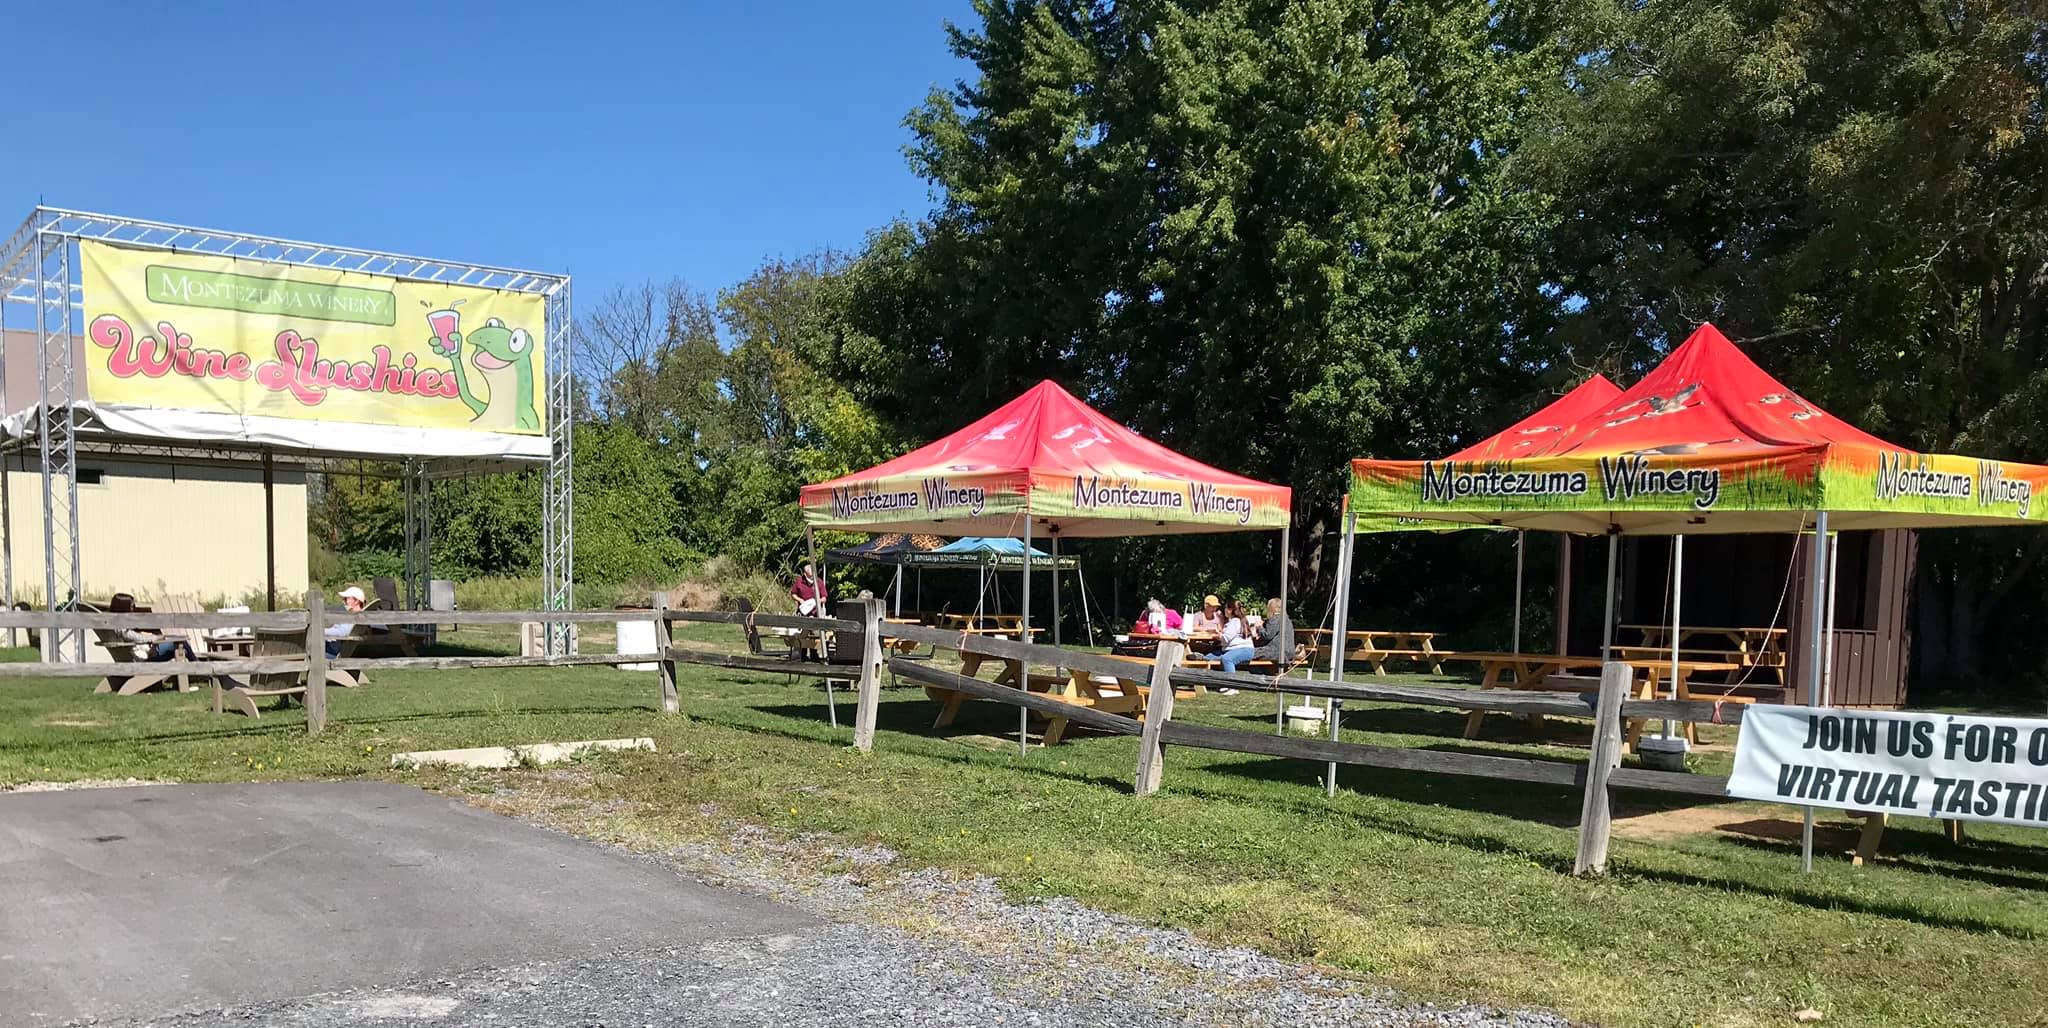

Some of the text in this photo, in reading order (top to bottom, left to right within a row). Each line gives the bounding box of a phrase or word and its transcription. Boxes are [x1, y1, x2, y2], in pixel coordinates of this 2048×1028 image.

[161, 273, 382, 315] MONTEZUMA WINERY
[90, 314, 460, 406] Wine Slushies
[832, 476, 984, 519] Montezuma Winery
[1075, 474, 1252, 525] Montezuma Winery
[1423, 455, 1719, 509] Montezuma Winery
[1877, 451, 2031, 519] Montezuma Winery
[1803, 715, 1877, 754] JOIN
[1887, 720, 1935, 758] US
[1944, 723, 2018, 764] FOR
[1777, 764, 1919, 809] VIRTUAL
